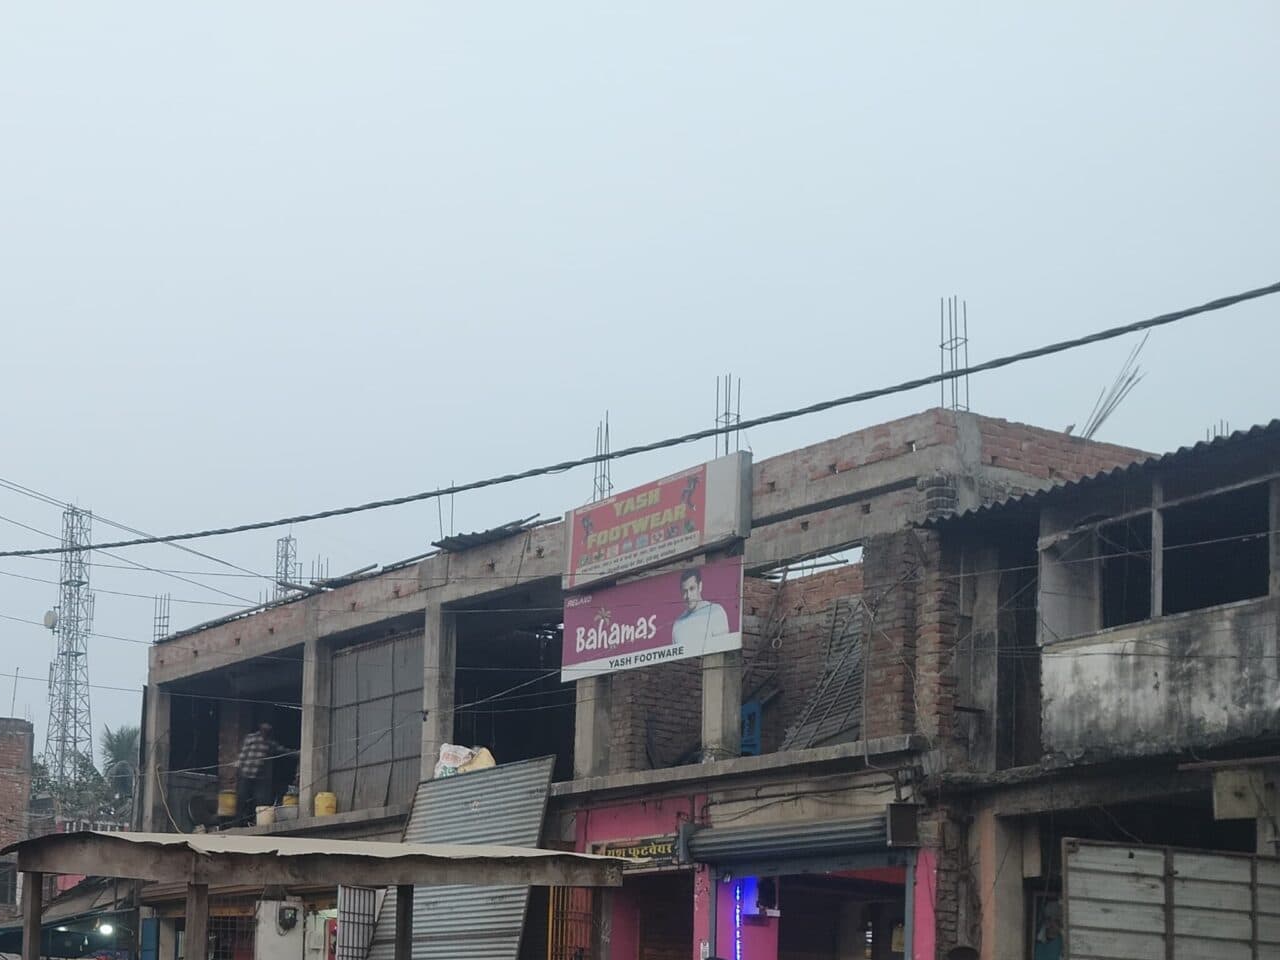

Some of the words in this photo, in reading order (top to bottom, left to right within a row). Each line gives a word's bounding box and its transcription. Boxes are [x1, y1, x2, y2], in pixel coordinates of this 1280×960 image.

[613, 488, 660, 517] YASH
[587, 504, 686, 549] FOOTWEAR
[576, 614, 657, 653] Bahamas
[609, 656, 632, 669] YASH
[634, 646, 684, 665] FOOTWARE
